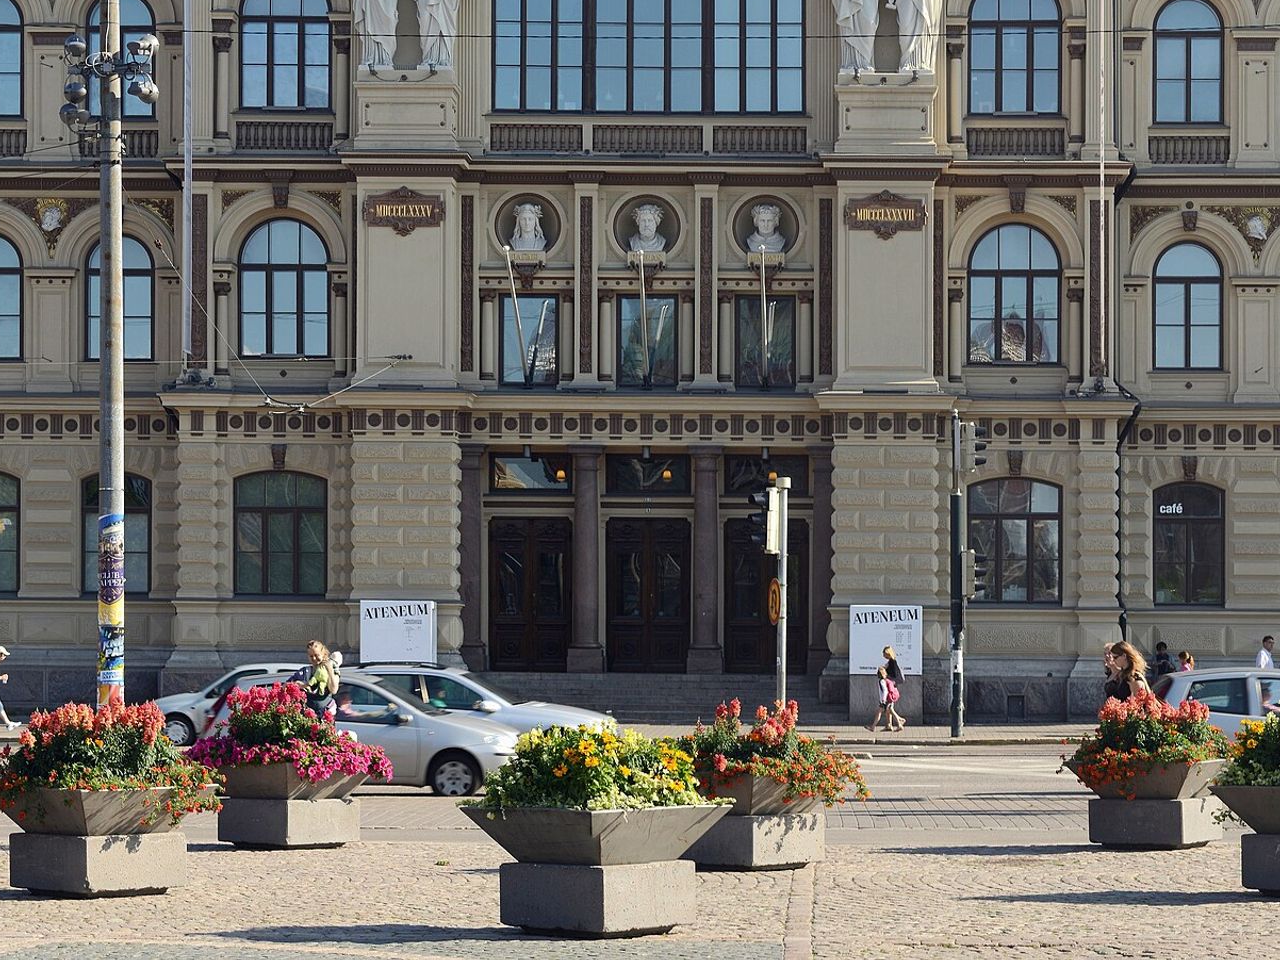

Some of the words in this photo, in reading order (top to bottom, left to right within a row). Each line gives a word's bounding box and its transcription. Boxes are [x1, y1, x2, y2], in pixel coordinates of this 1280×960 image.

[1159, 502, 1184, 514] café
[363, 603, 429, 620] ATENEUM
[853, 608, 919, 625] ATENEUM
